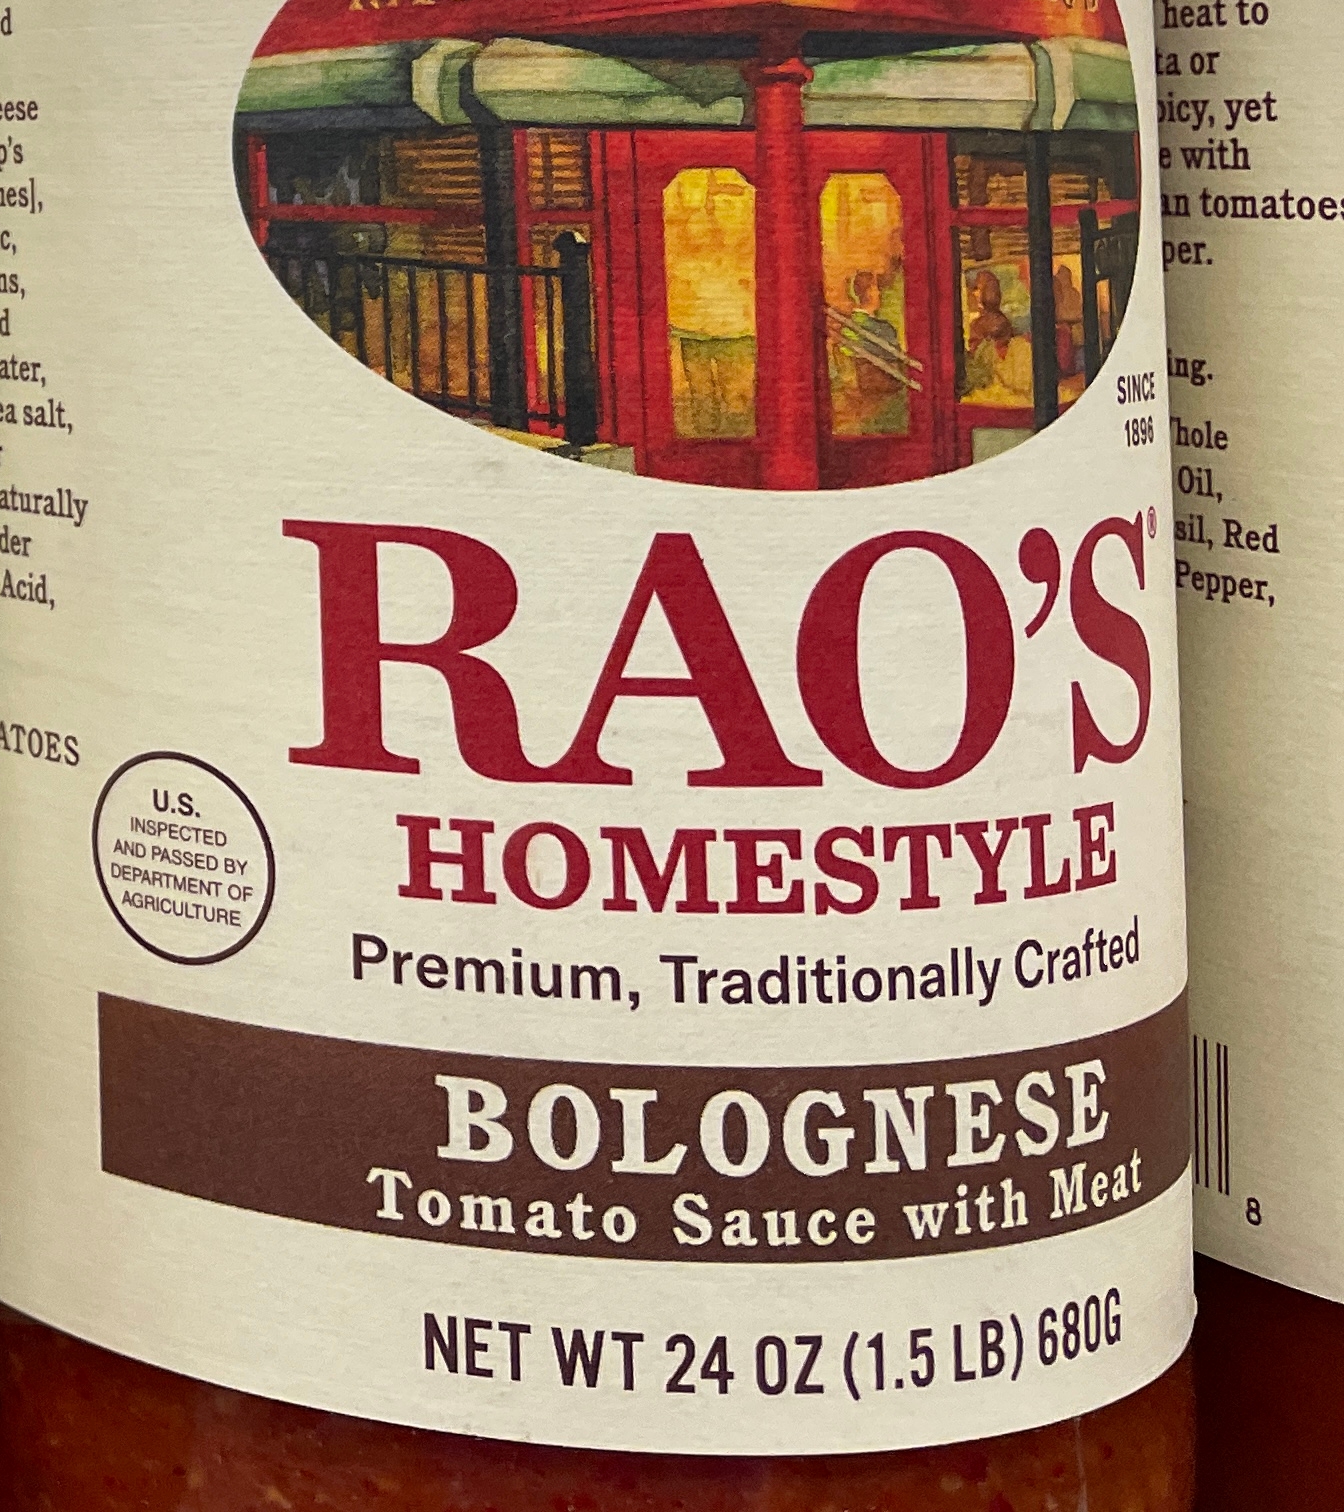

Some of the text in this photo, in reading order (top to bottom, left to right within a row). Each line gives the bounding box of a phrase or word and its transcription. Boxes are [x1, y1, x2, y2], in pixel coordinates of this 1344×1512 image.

[1190, 51, 1221, 75] or
[1224, 91, 1278, 131] yet
[1181, 138, 1251, 170] with
[1117, 371, 1155, 405] SINCE
[23, 398, 73, 435] salt,
[1124, 415, 1154, 448] 1896
[1178, 465, 1223, 503] Oil,
[1223, 518, 1280, 553] Red
[0, 569, 55, 611] Acid,
[1175, 559, 1275, 607] Pepper,
[153, 788, 201, 818] U.S.
[130, 816, 227, 847] INSPECTED
[113, 838, 248, 876] AND PASSED BY
[396, 800, 1117, 917] HOMESTYLE
[111, 862, 254, 903] DEPARTMENT OF
[121, 890, 242, 928] AGRICULTURE
[351, 915, 1141, 1010] Premium, Traditionally Crafted
[435, 1058, 1110, 1178] BOLOGNESE
[365, 1148, 1143, 1248] Tomato Sauce with Meat
[1245, 1196, 1262, 1226] 8
[424, 1287, 1122, 1400] NET WT 24 OZ (1.5 LB) 680G
